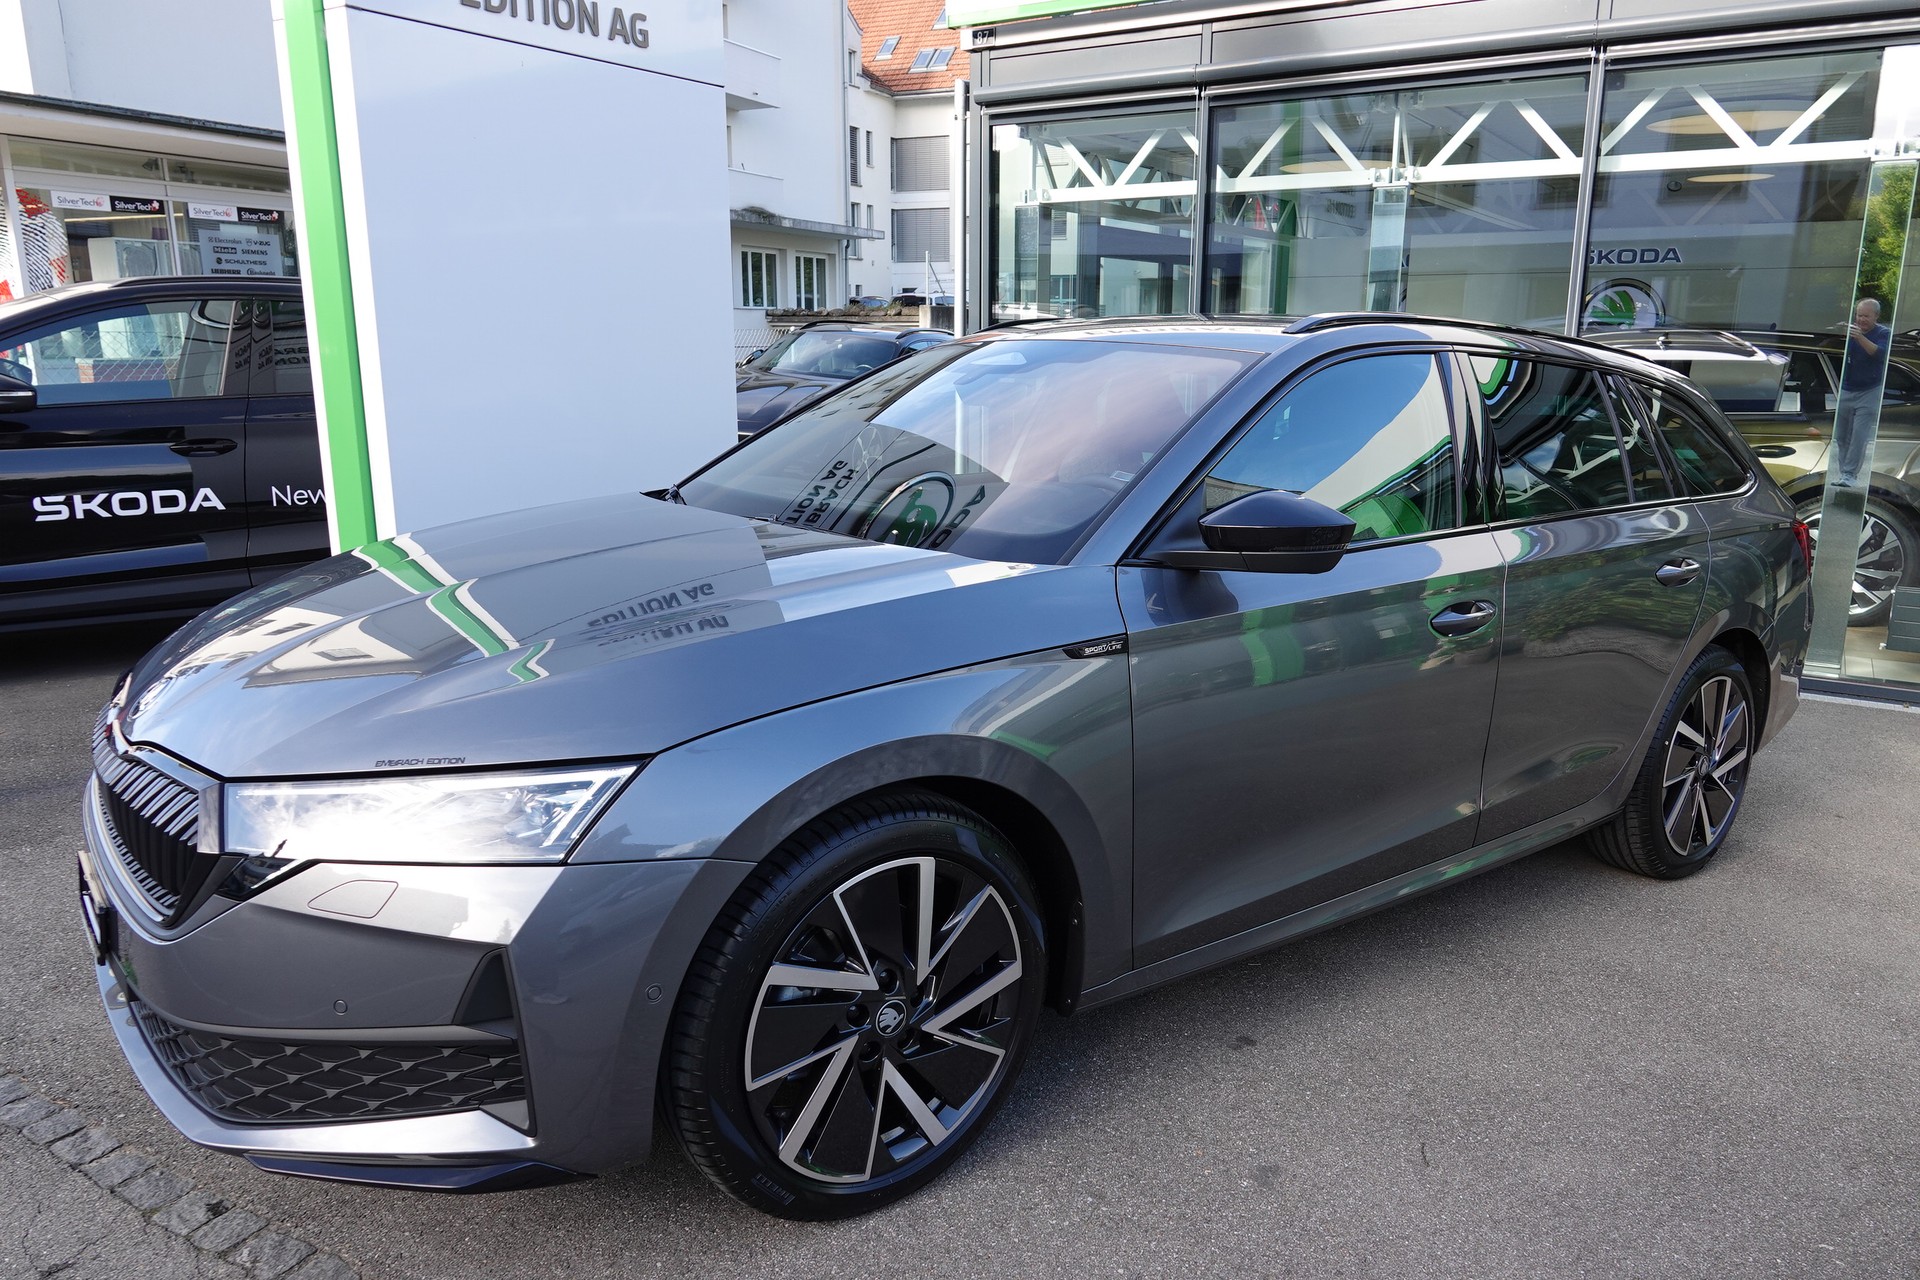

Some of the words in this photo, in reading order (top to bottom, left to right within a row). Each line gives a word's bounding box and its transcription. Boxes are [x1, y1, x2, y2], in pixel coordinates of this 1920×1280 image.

[608, 8, 650, 49] AG
[977, 31, 989, 44] 87
[114, 200, 153, 211] SilverTech
[241, 211, 273, 221] SilverTech
[214, 237, 242, 245] Electrolux
[213, 246, 237, 254] Miele
[224, 258, 267, 266] SCHULTHESS
[271, 485, 327, 507] New
[375, 758, 424, 768] EMBRACH
[426, 757, 466, 765] EDITION
